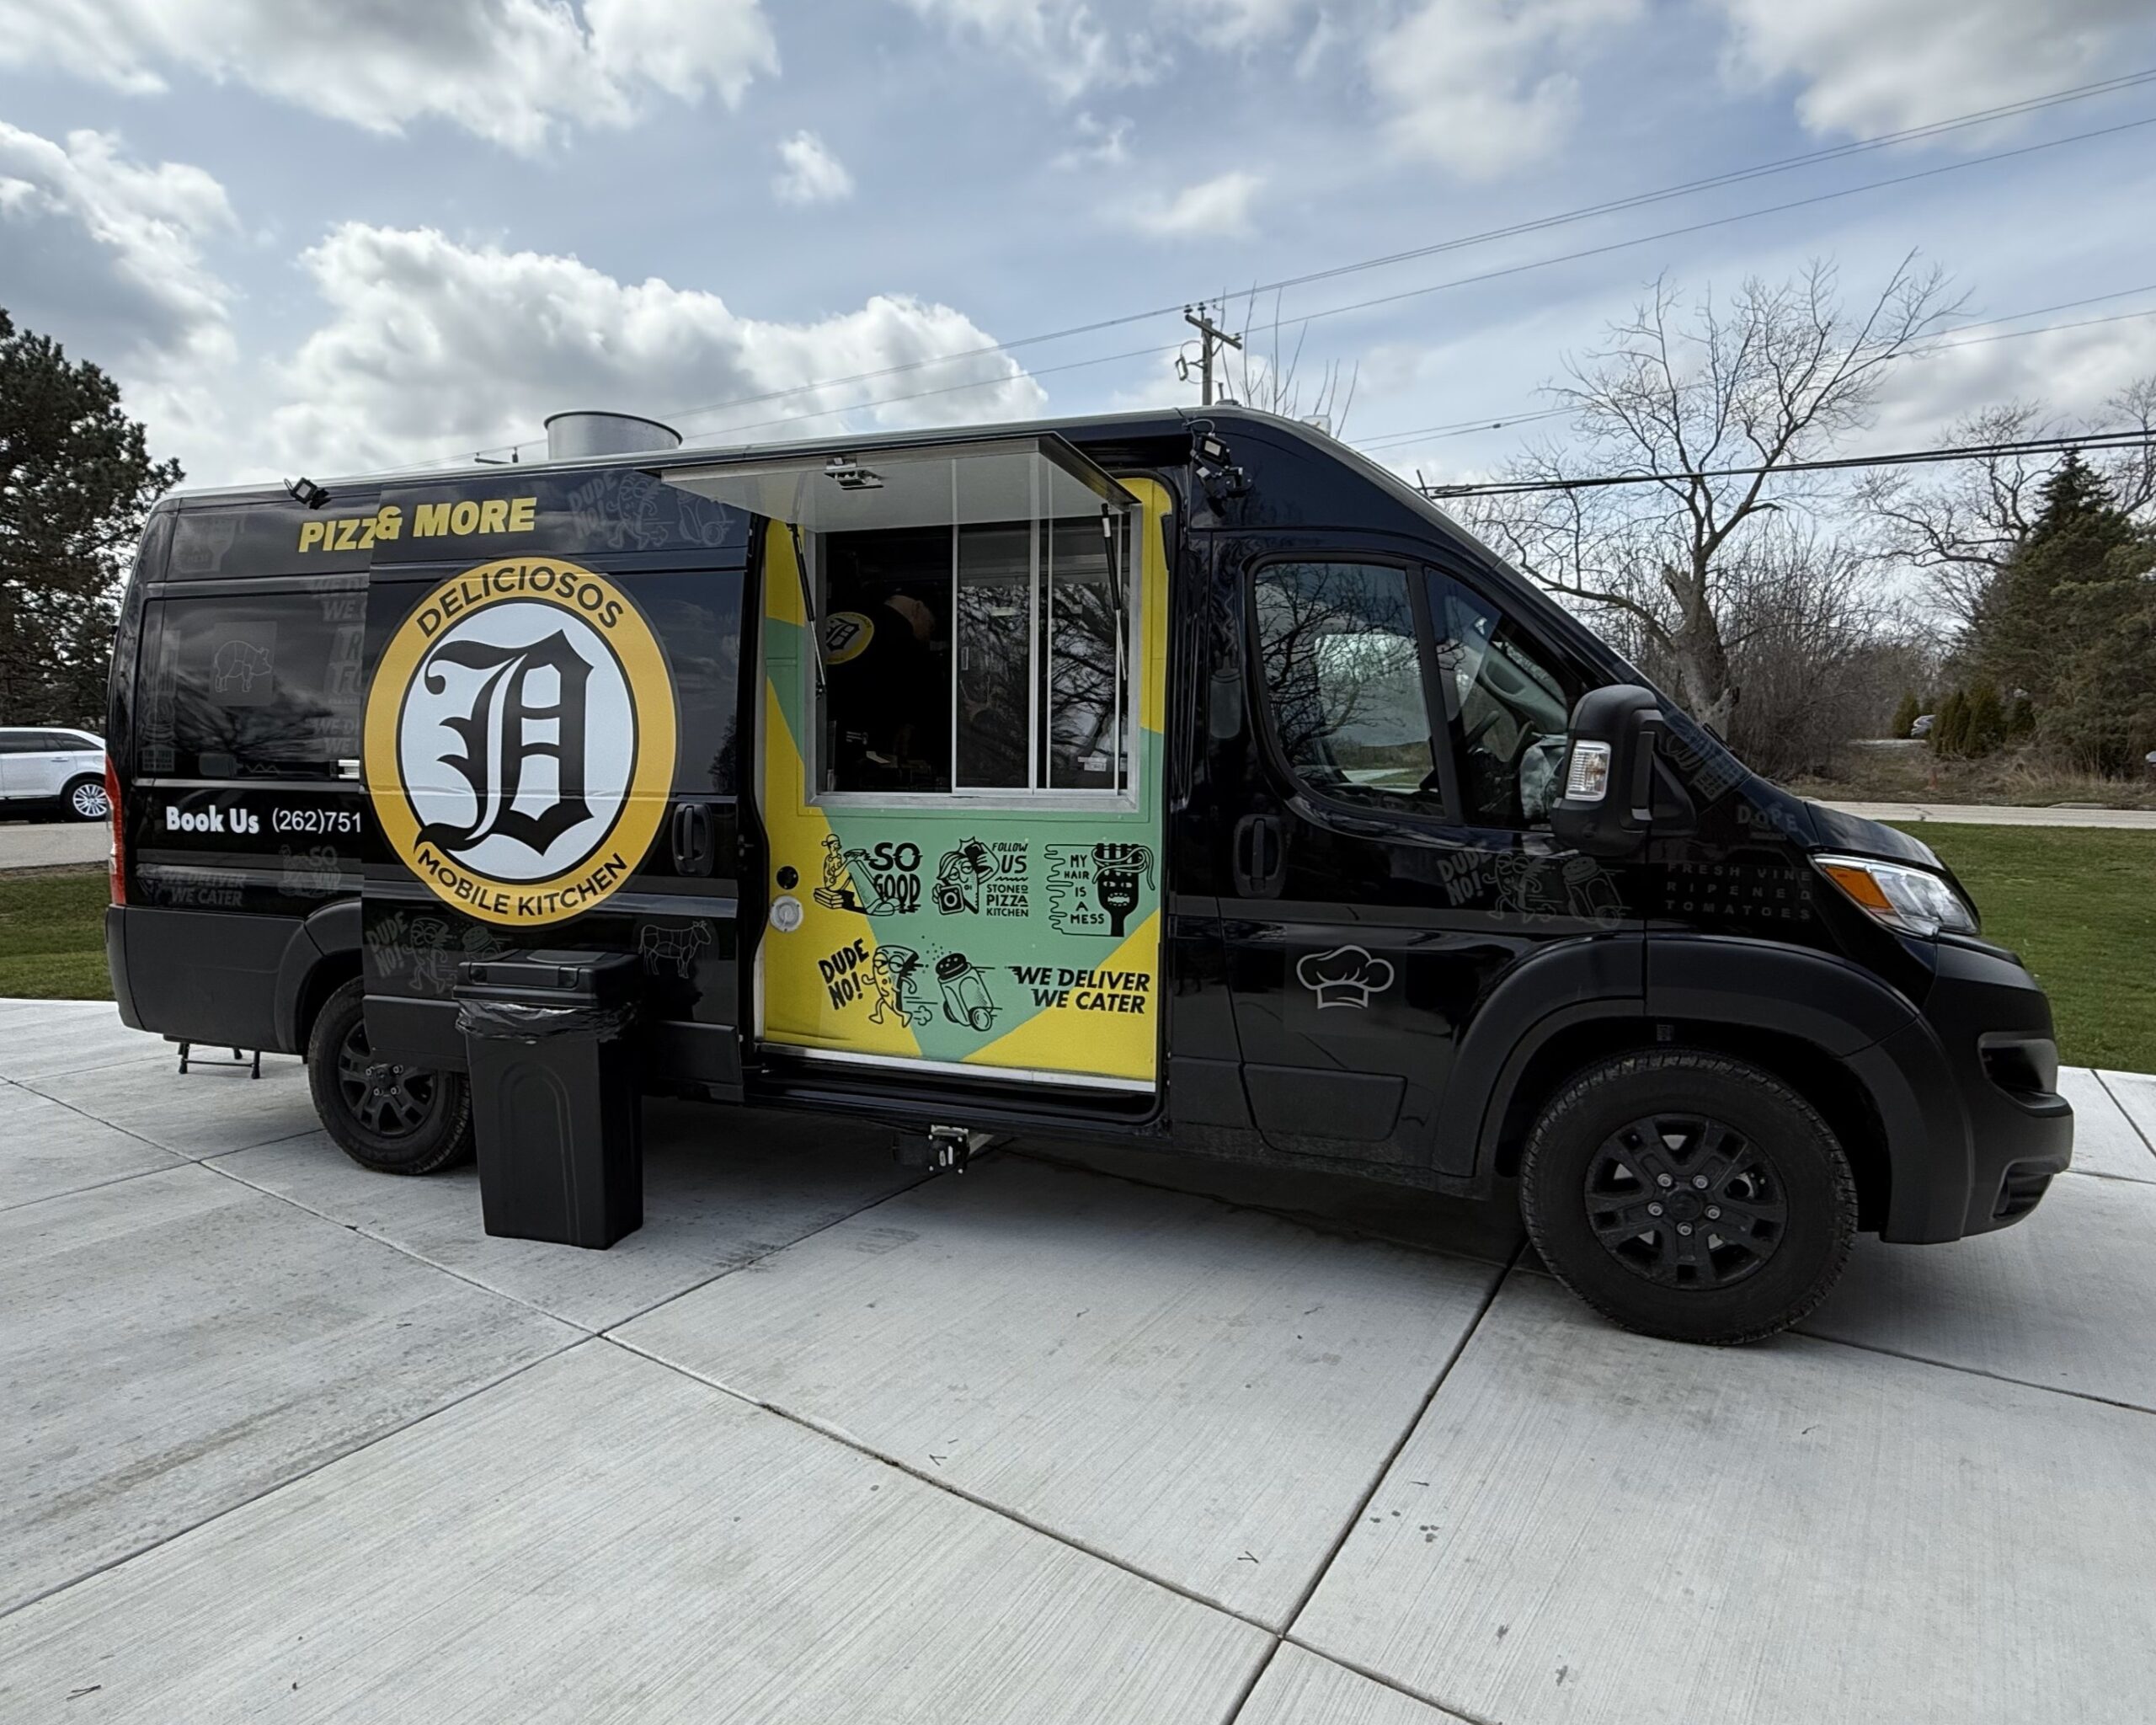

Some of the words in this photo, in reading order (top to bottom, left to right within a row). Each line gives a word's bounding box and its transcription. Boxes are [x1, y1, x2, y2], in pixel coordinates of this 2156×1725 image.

[376, 506, 403, 540] &
[413, 497, 537, 537] MORE
[416, 566, 623, 638] DELICIOSOS
[166, 804, 226, 833] Book
[229, 808, 260, 835] Us
[271, 806, 361, 835] (262)751
[1737, 802, 1798, 832] DOPE
[867, 842, 923, 872] SO
[992, 842, 1028, 852] FOLLOW
[1001, 854, 1027, 873] US
[1070, 854, 1087, 868] MY
[1667, 862, 1741, 877] FRESH
[1757, 868, 1811, 882] VINE
[418, 849, 510, 915] MOBILE
[518, 852, 627, 916] KITCHEN
[1064, 871, 1090, 879] HAIR
[874, 873, 921, 914] GOOD
[986, 884, 1029, 894] STONED
[1075, 887, 1086, 897] IS
[1445, 869, 1484, 907] NO!
[1666, 881, 1811, 900] RIPENED
[986, 895, 1029, 907] PIZZA
[986, 908, 1029, 917] KITCHEN
[1075, 901, 1088, 911] A
[1664, 900, 1810, 920] TOMATOES
[1070, 914, 1104, 924] MESS
[366, 911, 408, 953] DUDE
[374, 941, 404, 978] NO!
[818, 937, 869, 984] DUDE
[828, 971, 863, 1010] NO!
[1009, 966, 1053, 985] WE
[1056, 969, 1150, 992] DELIVER
[1031, 989, 1070, 1007] WE
[1075, 991, 1145, 1014] CATER
